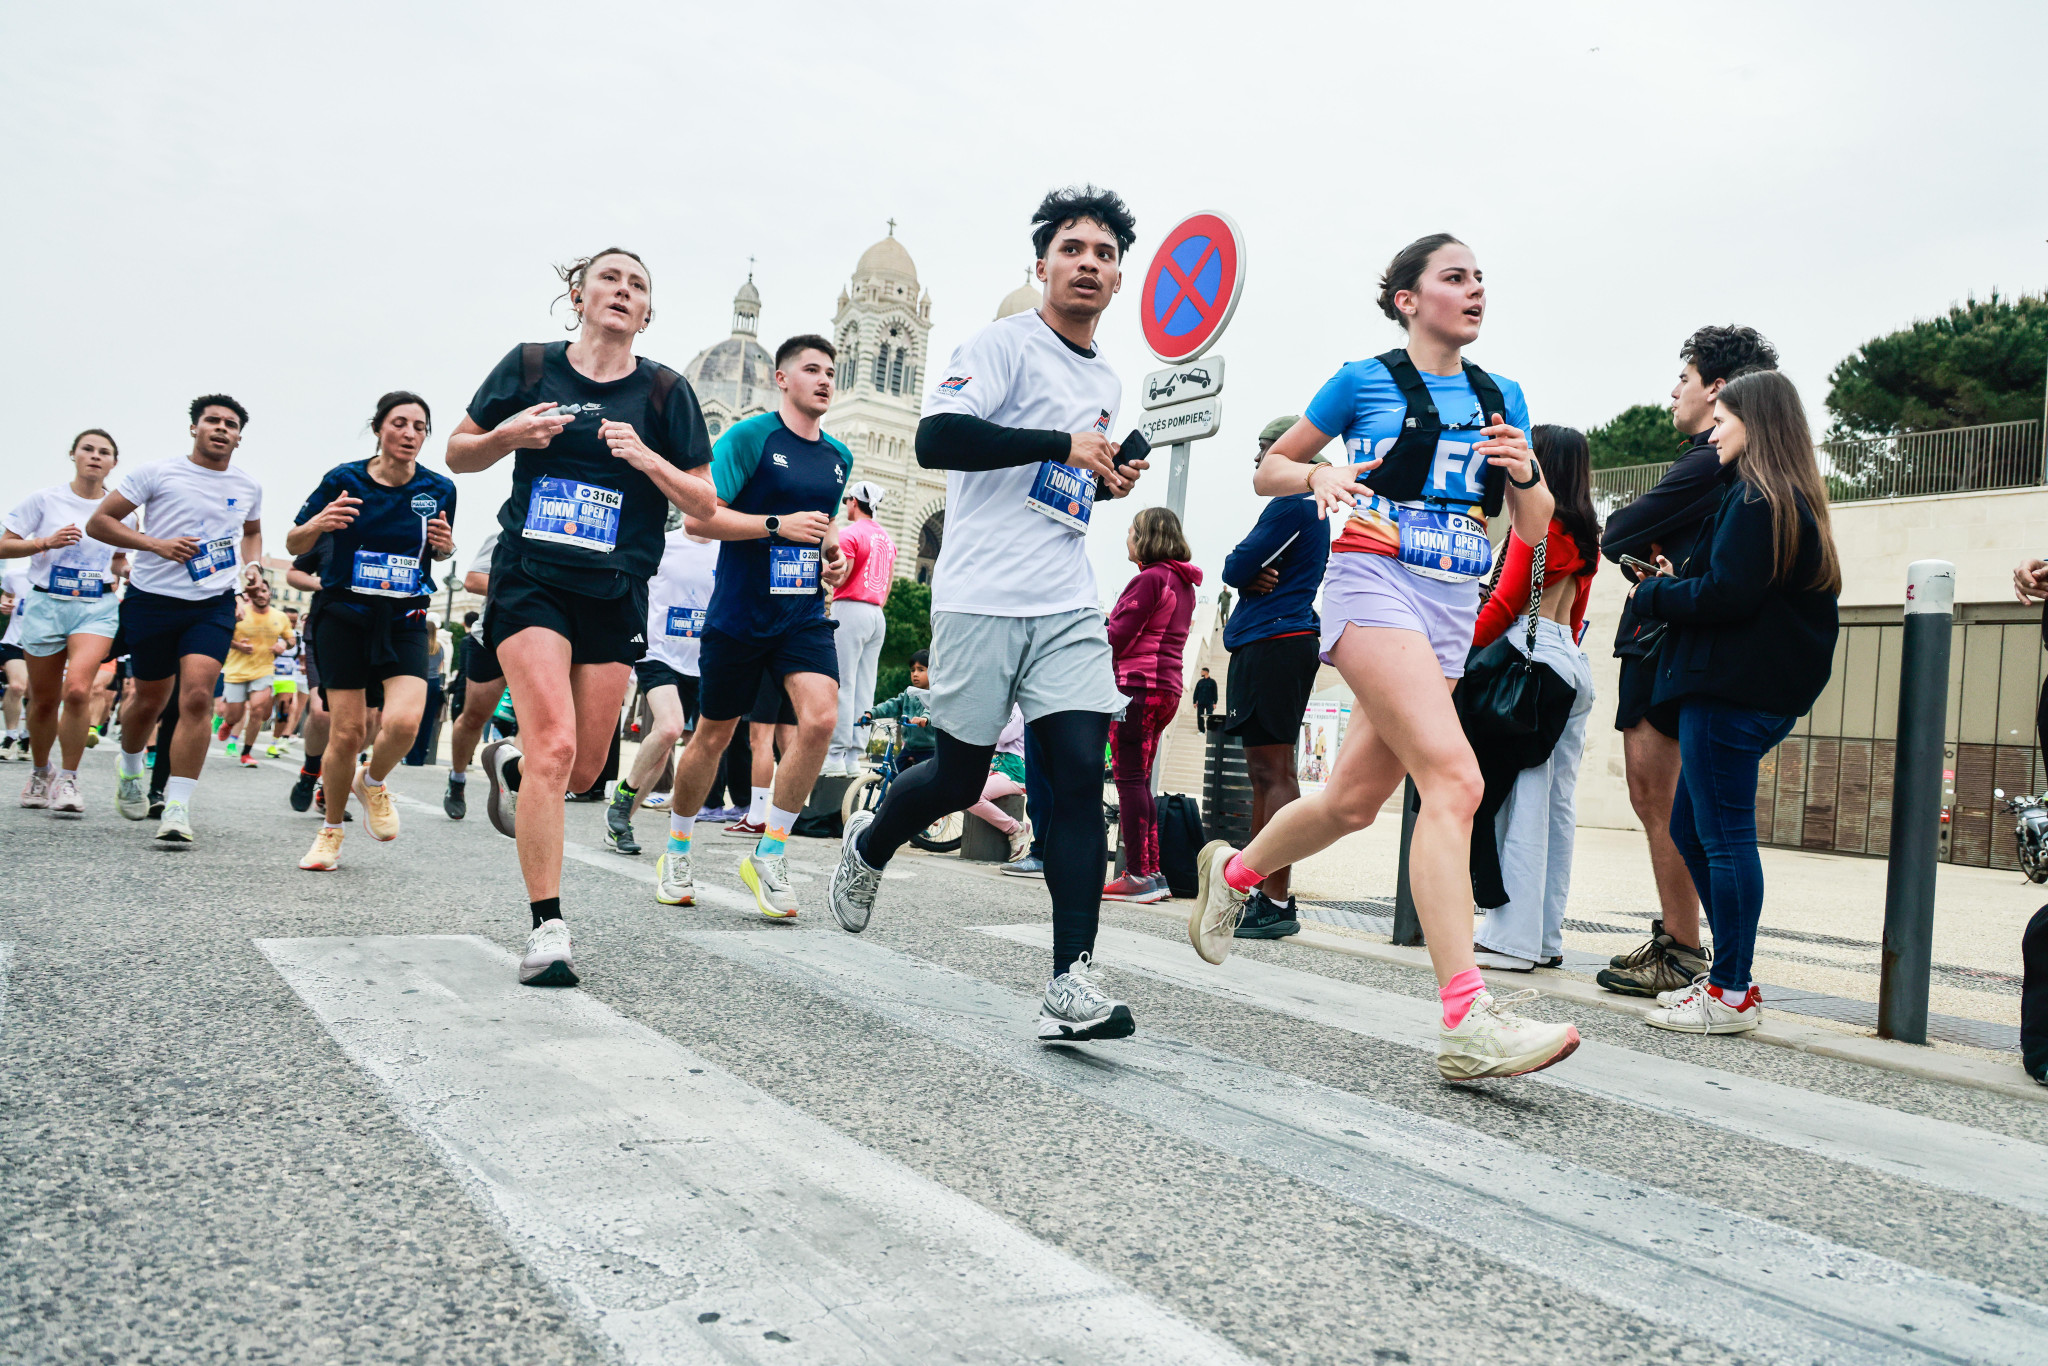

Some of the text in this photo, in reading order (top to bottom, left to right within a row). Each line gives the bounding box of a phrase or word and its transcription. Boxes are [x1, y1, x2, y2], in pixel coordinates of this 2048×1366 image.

[1142, 418, 1167, 433] CÈS
[1050, 470, 1081, 498] 10KM
[592, 490, 619, 506] 3164
[541, 500, 605, 520] 10KM OPEN
[1413, 530, 1478, 551] 10KM OPEN
[399, 558, 417, 567] 1087
[780, 563, 801, 576] 10KM
[362, 565, 410, 579] 10KM OPEN
[1257, 912, 1280, 926] HOKA
